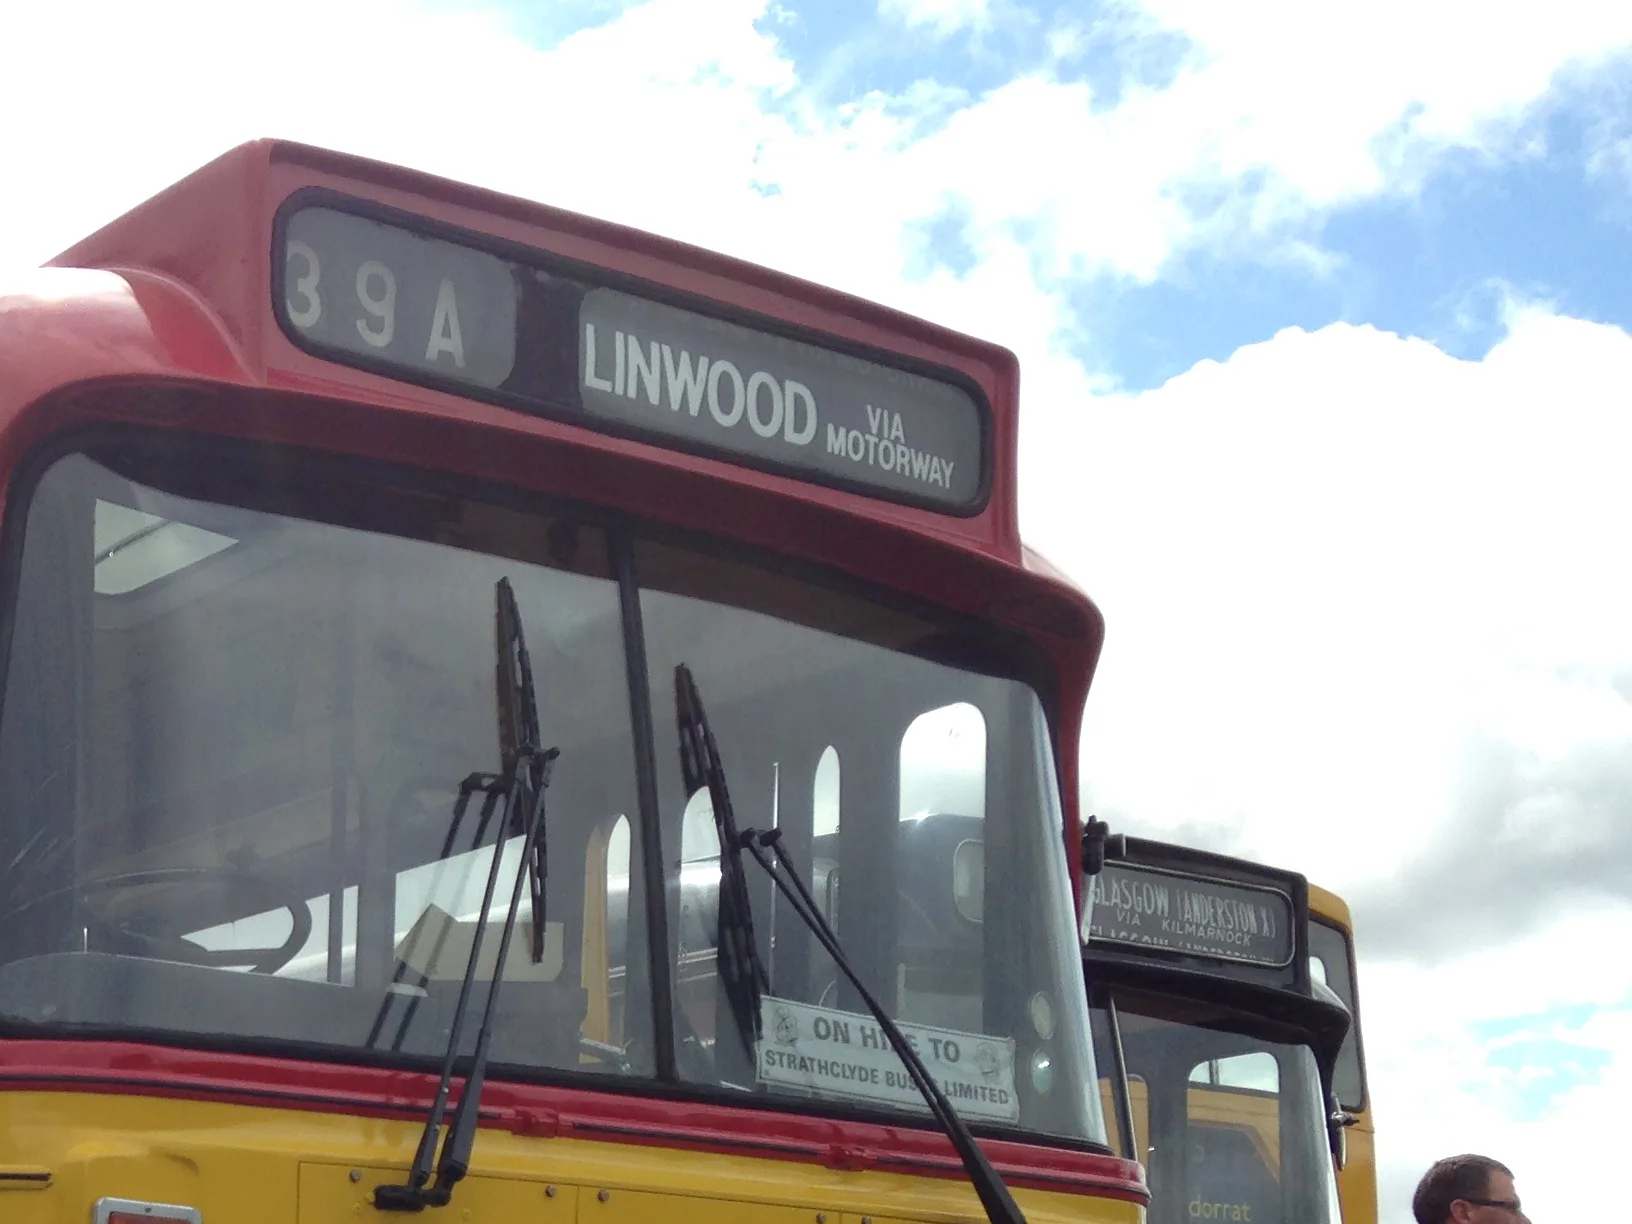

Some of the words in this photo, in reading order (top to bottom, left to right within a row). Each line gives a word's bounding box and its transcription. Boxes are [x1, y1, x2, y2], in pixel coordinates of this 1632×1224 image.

[583, 322, 817, 446] LINWOOD
[866, 404, 905, 445] VIA
[826, 423, 955, 490] MOTORWAY
[1116, 909, 1141, 926] VIA
[1162, 918, 1252, 946] KILMARNOCK
[814, 1016, 850, 1044] ON
[860, 1025, 920, 1057] HIE
[928, 1037, 960, 1063] TO
[766, 1050, 879, 1084] STRATHCLYDE
[885, 1070, 939, 1095] BUS
[944, 1080, 1009, 1105] LIMITED
